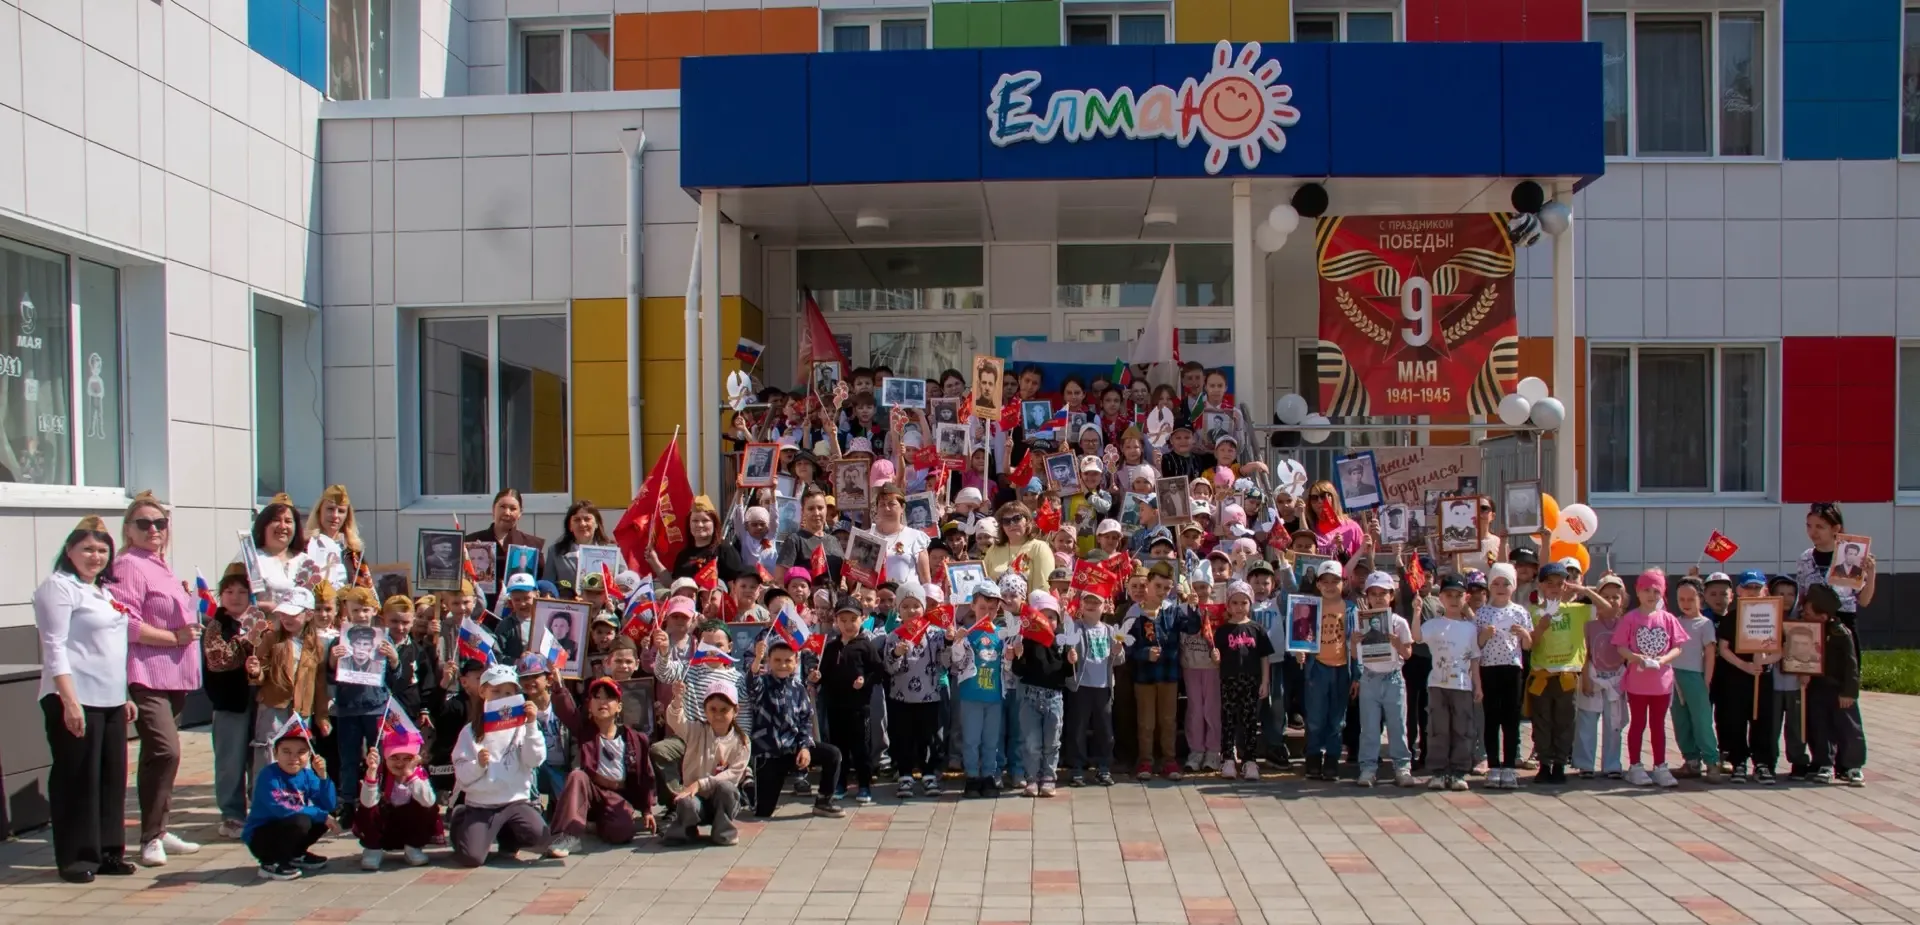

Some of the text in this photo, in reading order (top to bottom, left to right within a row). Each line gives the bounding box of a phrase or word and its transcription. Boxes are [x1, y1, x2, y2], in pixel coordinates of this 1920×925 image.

[1379, 219, 1454, 231] С ПРАЗДНИКОМ
[1379, 233, 1454, 252] ПОБЕДЫ!
[1401, 276, 1433, 347] 9
[1397, 360, 1438, 383] МАЯ
[1379, 454, 1464, 503] Гордимся!
